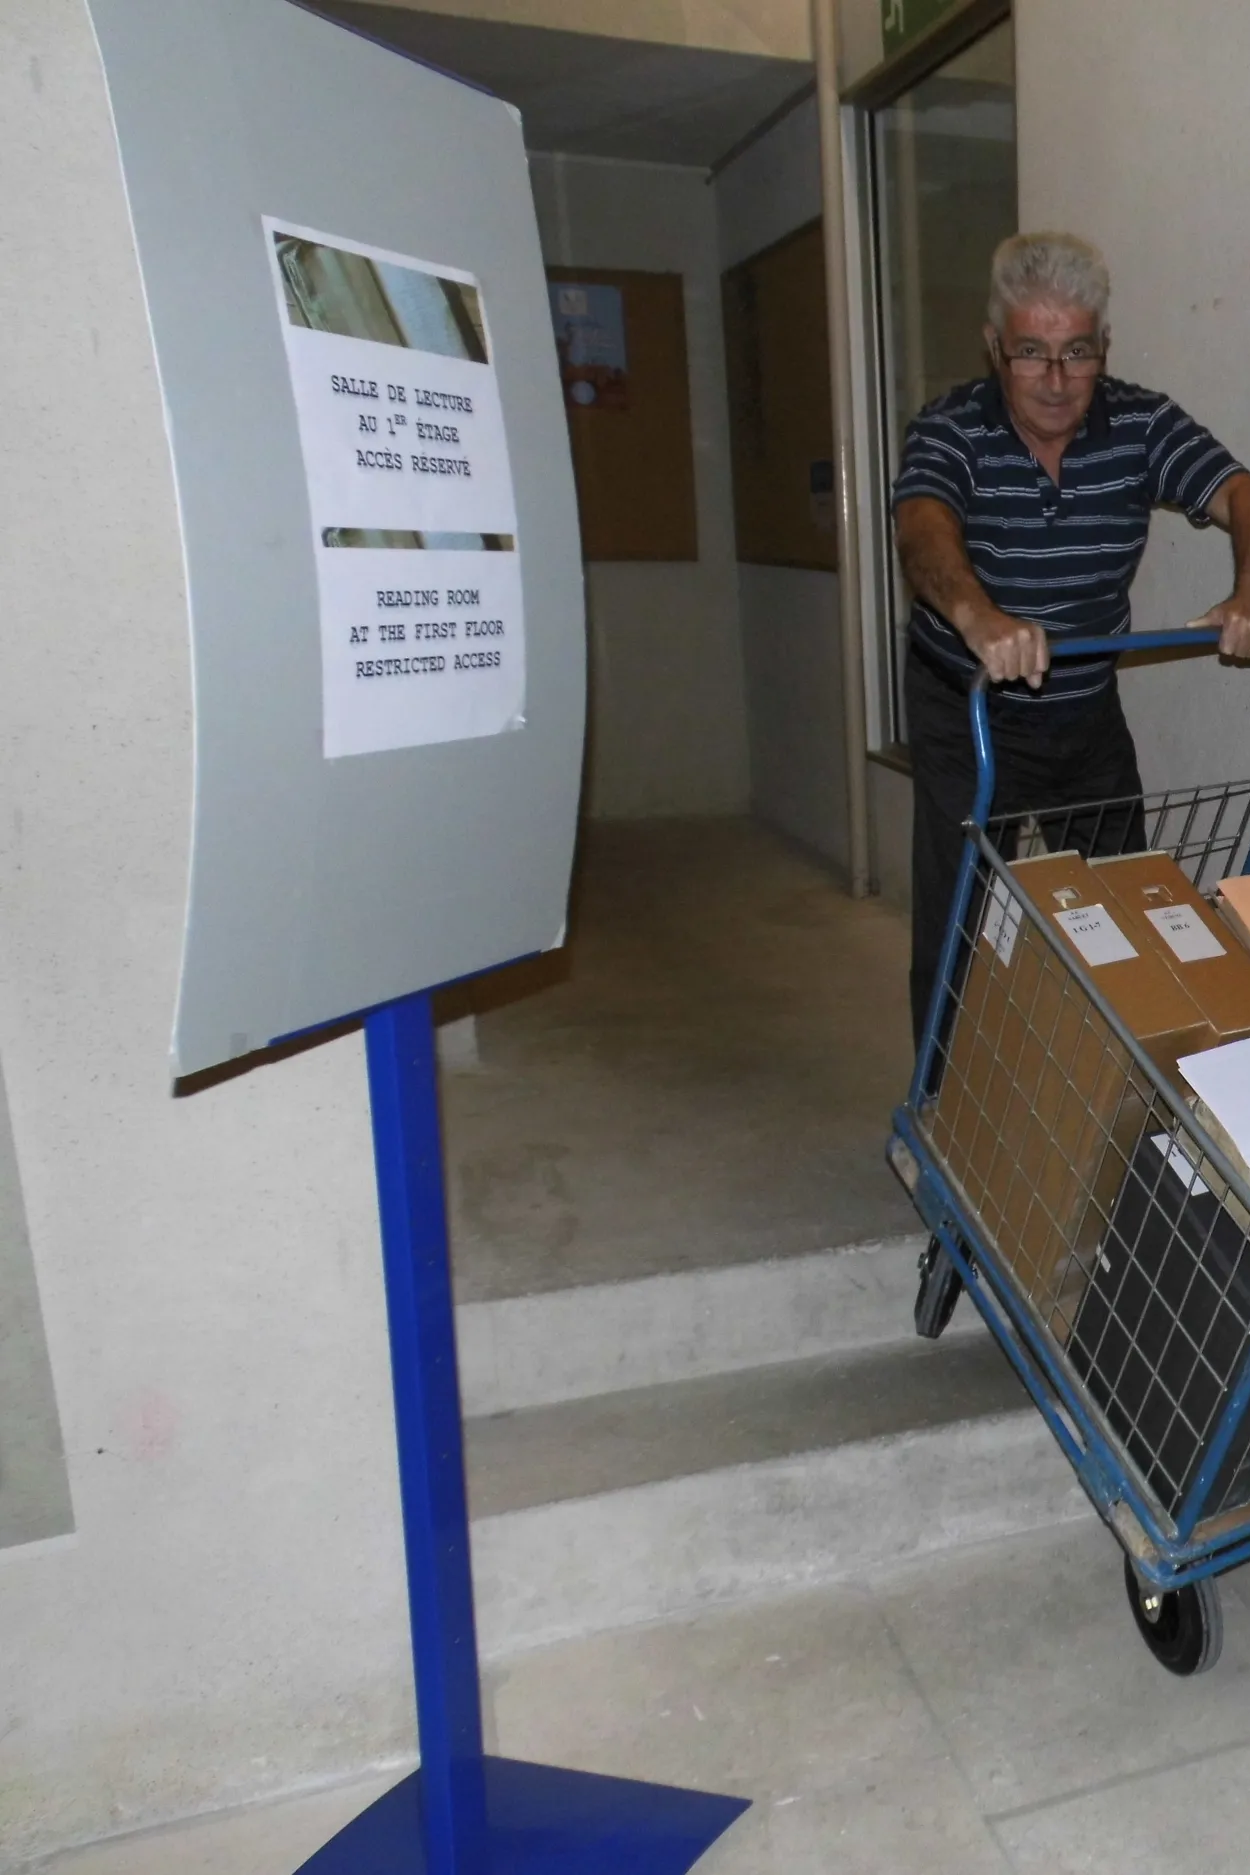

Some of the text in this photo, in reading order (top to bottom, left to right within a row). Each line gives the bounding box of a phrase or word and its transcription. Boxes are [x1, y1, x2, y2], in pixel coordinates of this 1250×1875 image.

[331, 375, 473, 413] SALLE DE LECTURE
[359, 415, 377, 432] AU
[416, 418, 460, 443] ÉTAGE
[356, 447, 472, 476] ACCÈS RÉSERVÉ
[377, 589, 480, 607] READING ROOM
[350, 620, 504, 643] AT THE FIRST FLOOR
[356, 651, 501, 678] RESTRICTED ACCESS
